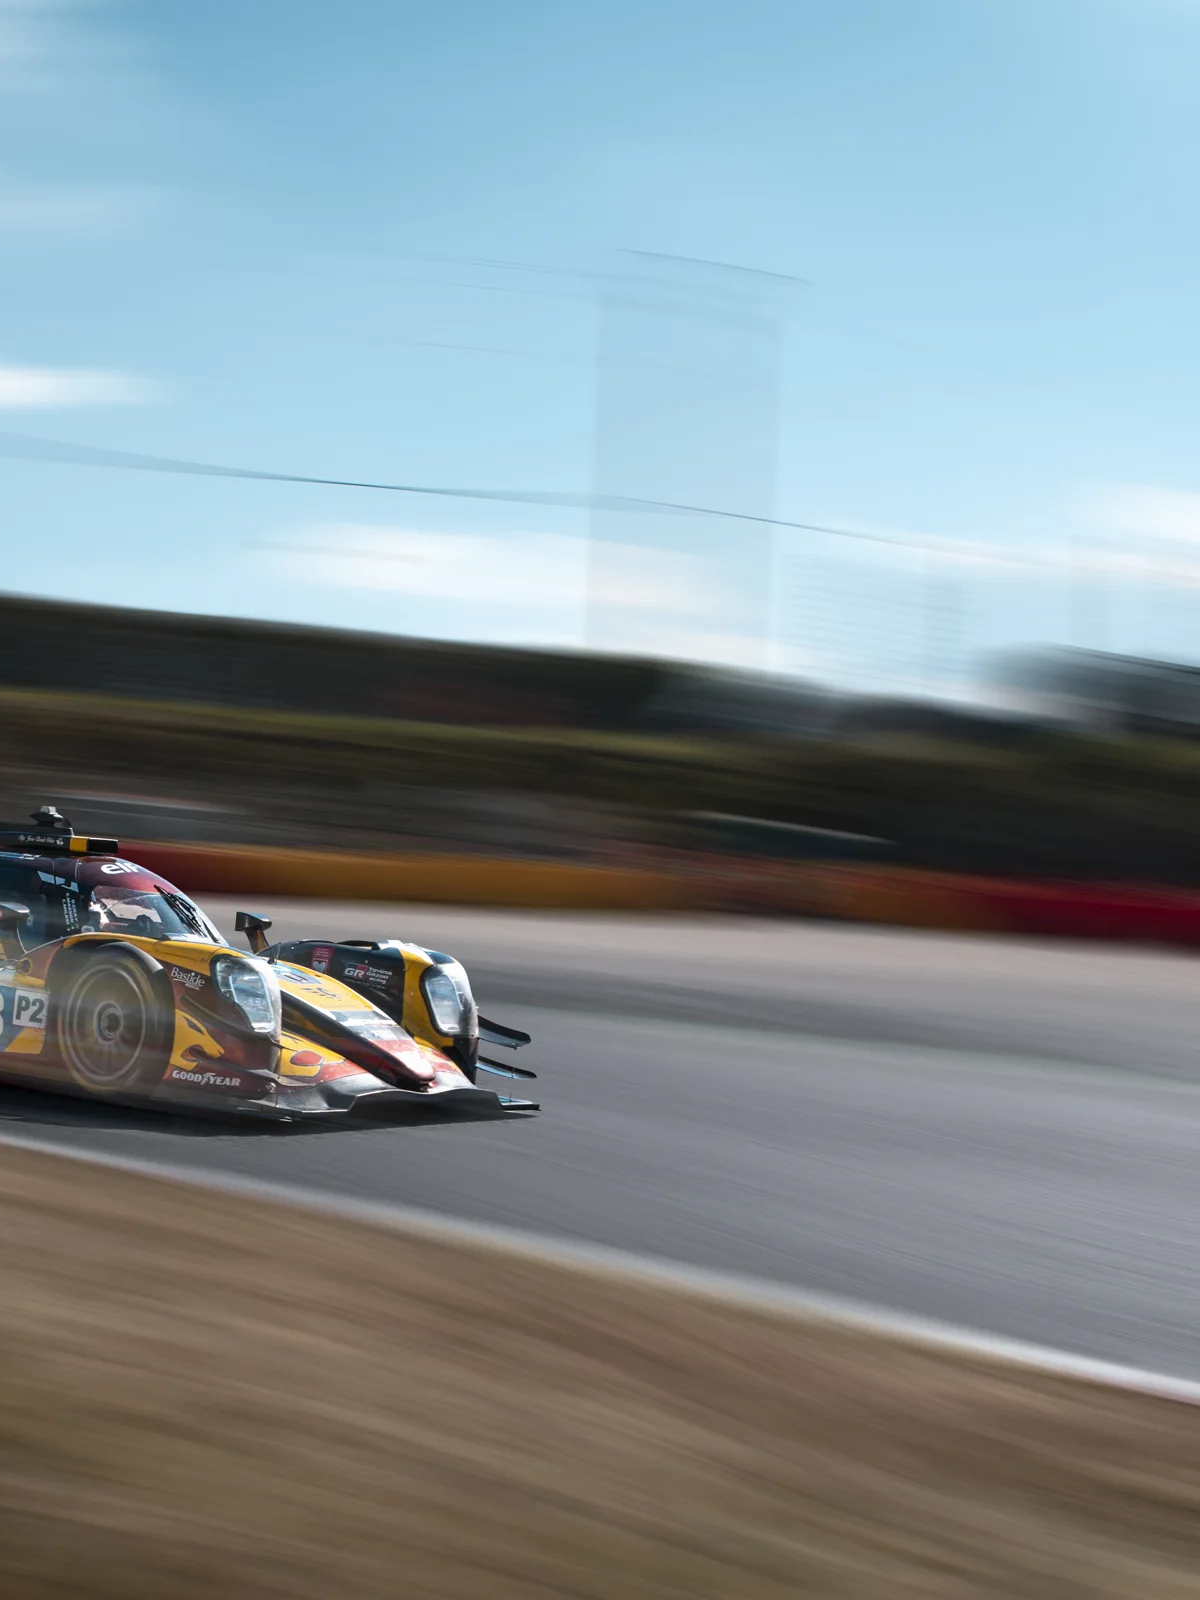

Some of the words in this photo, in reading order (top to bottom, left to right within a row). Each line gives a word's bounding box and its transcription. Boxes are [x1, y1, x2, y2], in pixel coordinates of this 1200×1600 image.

[100, 862, 139, 874] elf
[171, 966, 205, 986] Bastide
[344, 967, 365, 978] GR
[366, 971, 389, 980] GAZOO
[367, 966, 392, 975] TOYOTA
[15, 995, 45, 1023] P2
[172, 1069, 241, 1086] GOODYEAR
